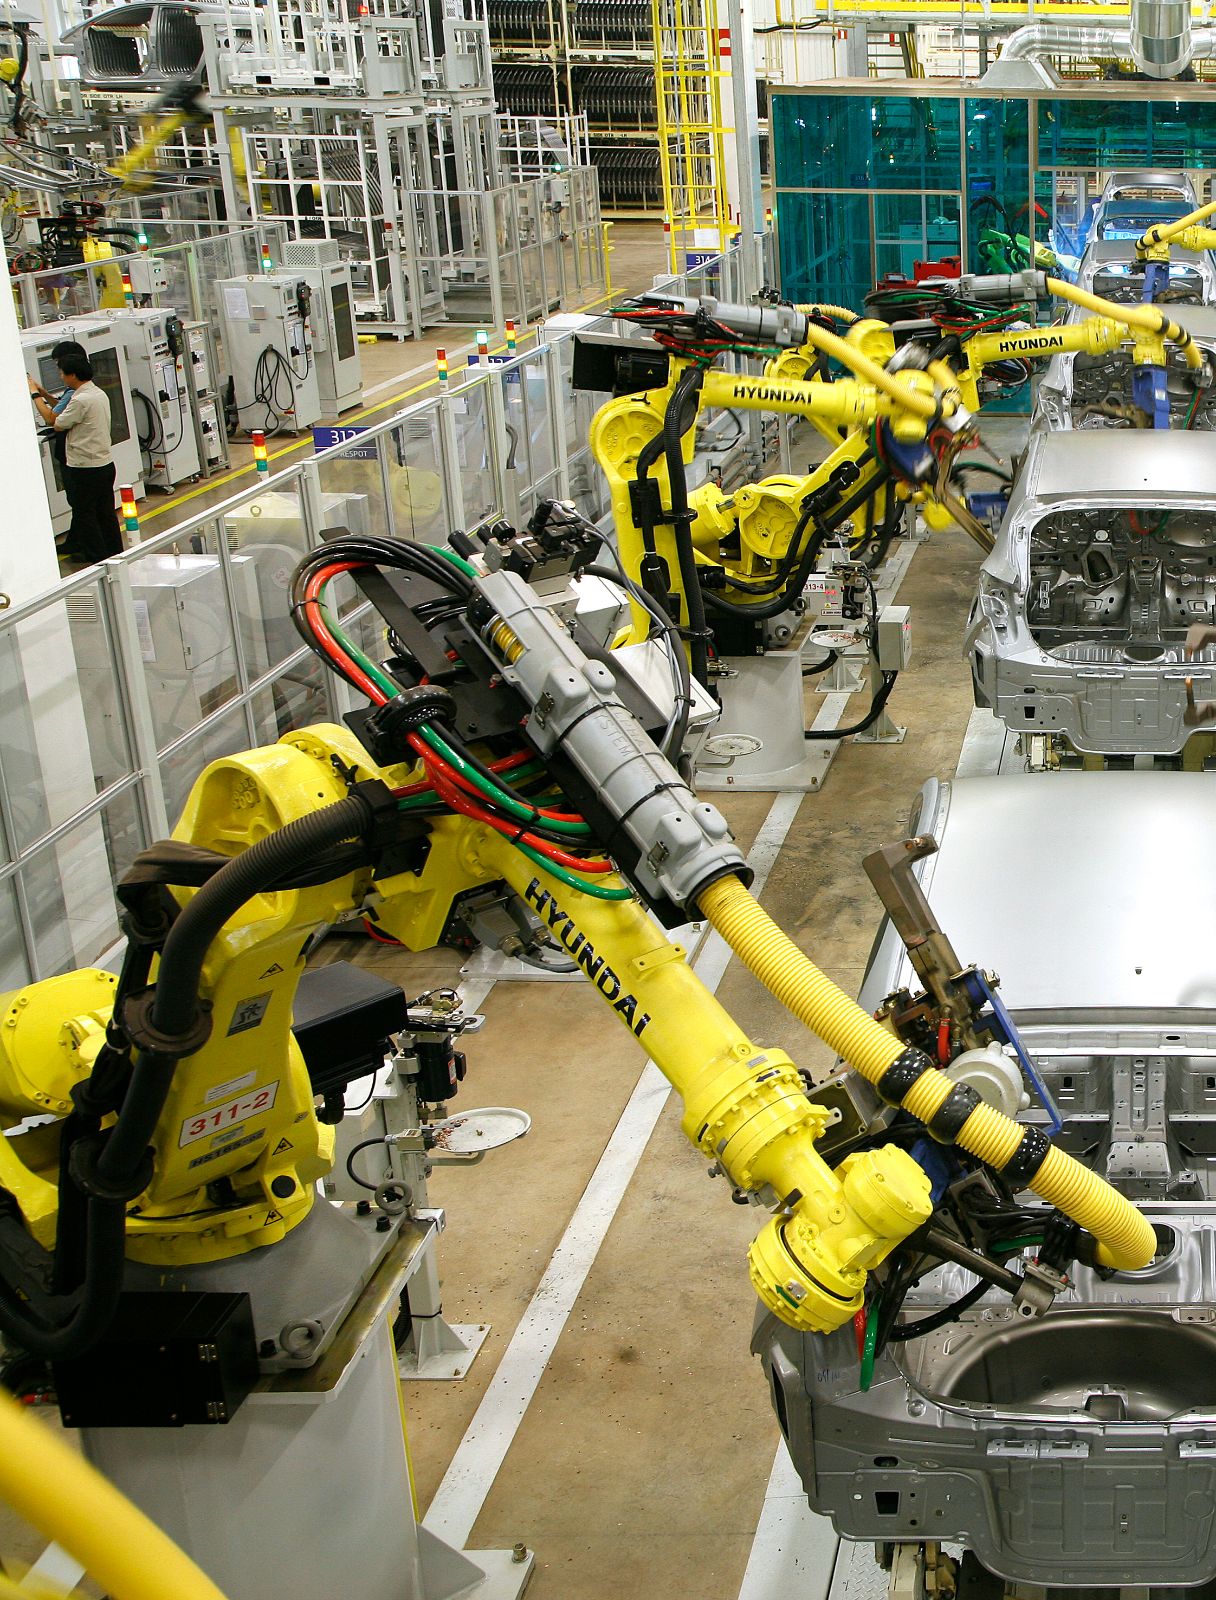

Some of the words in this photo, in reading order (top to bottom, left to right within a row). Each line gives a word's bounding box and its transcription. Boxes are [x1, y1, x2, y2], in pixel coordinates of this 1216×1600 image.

[1000, 336, 1063, 352] HYUNDAI
[734, 386, 812, 404] HYUNDAI
[524, 877, 652, 1038] HYUNDAI
[189, 1091, 270, 1136] 311-2
